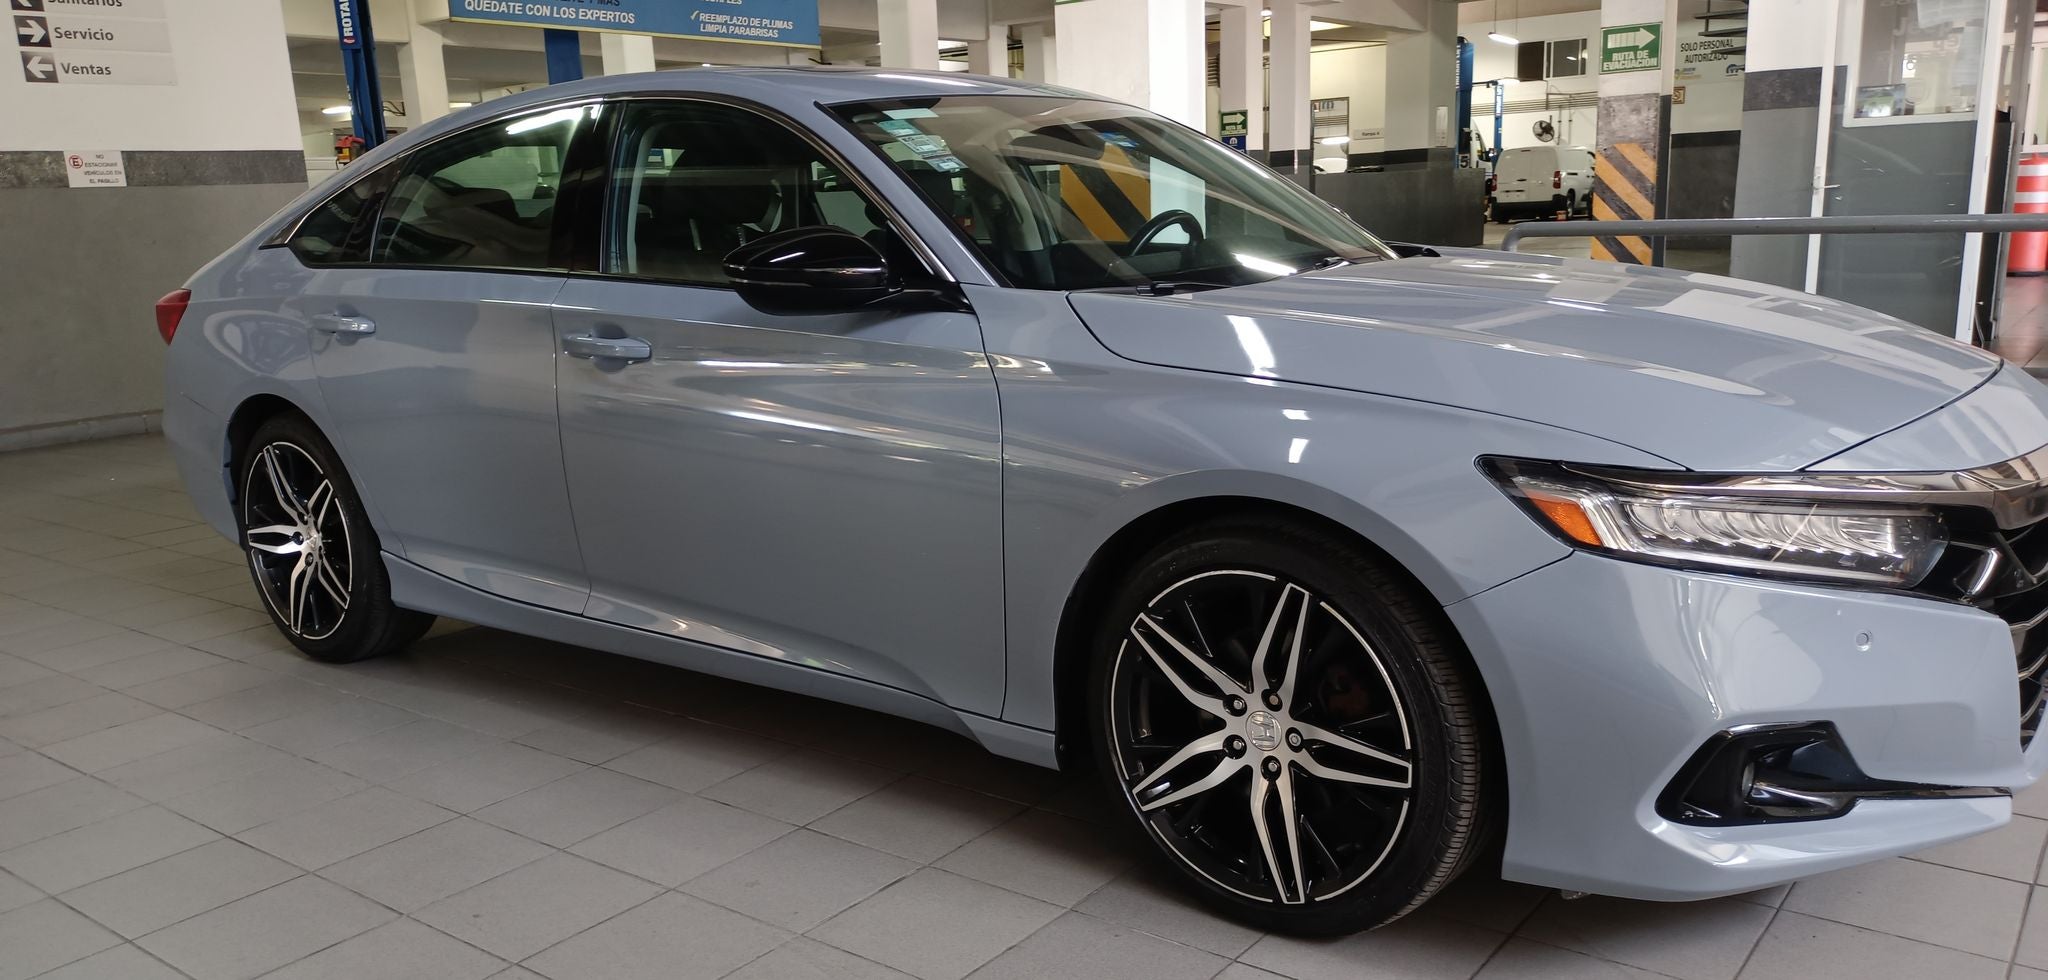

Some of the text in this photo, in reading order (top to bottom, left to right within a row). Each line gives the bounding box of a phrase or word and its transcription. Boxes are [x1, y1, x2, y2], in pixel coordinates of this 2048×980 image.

[464, 0, 635, 24] QUEDATE CON LOS EXPERTOS
[700, 13, 793, 29] REEMPLAZO DE PLUMAS
[54, 27, 114, 41] Servicio
[700, 24, 778, 38] LIMPIA PARABRISAS
[1680, 39, 1734, 52] SOLO PERSONAL
[1612, 50, 1649, 62] RUTA DE
[1684, 53, 1728, 63] AUTORIZADO
[60, 62, 112, 76] Ventas
[1460, 156, 1469, 168] 5
